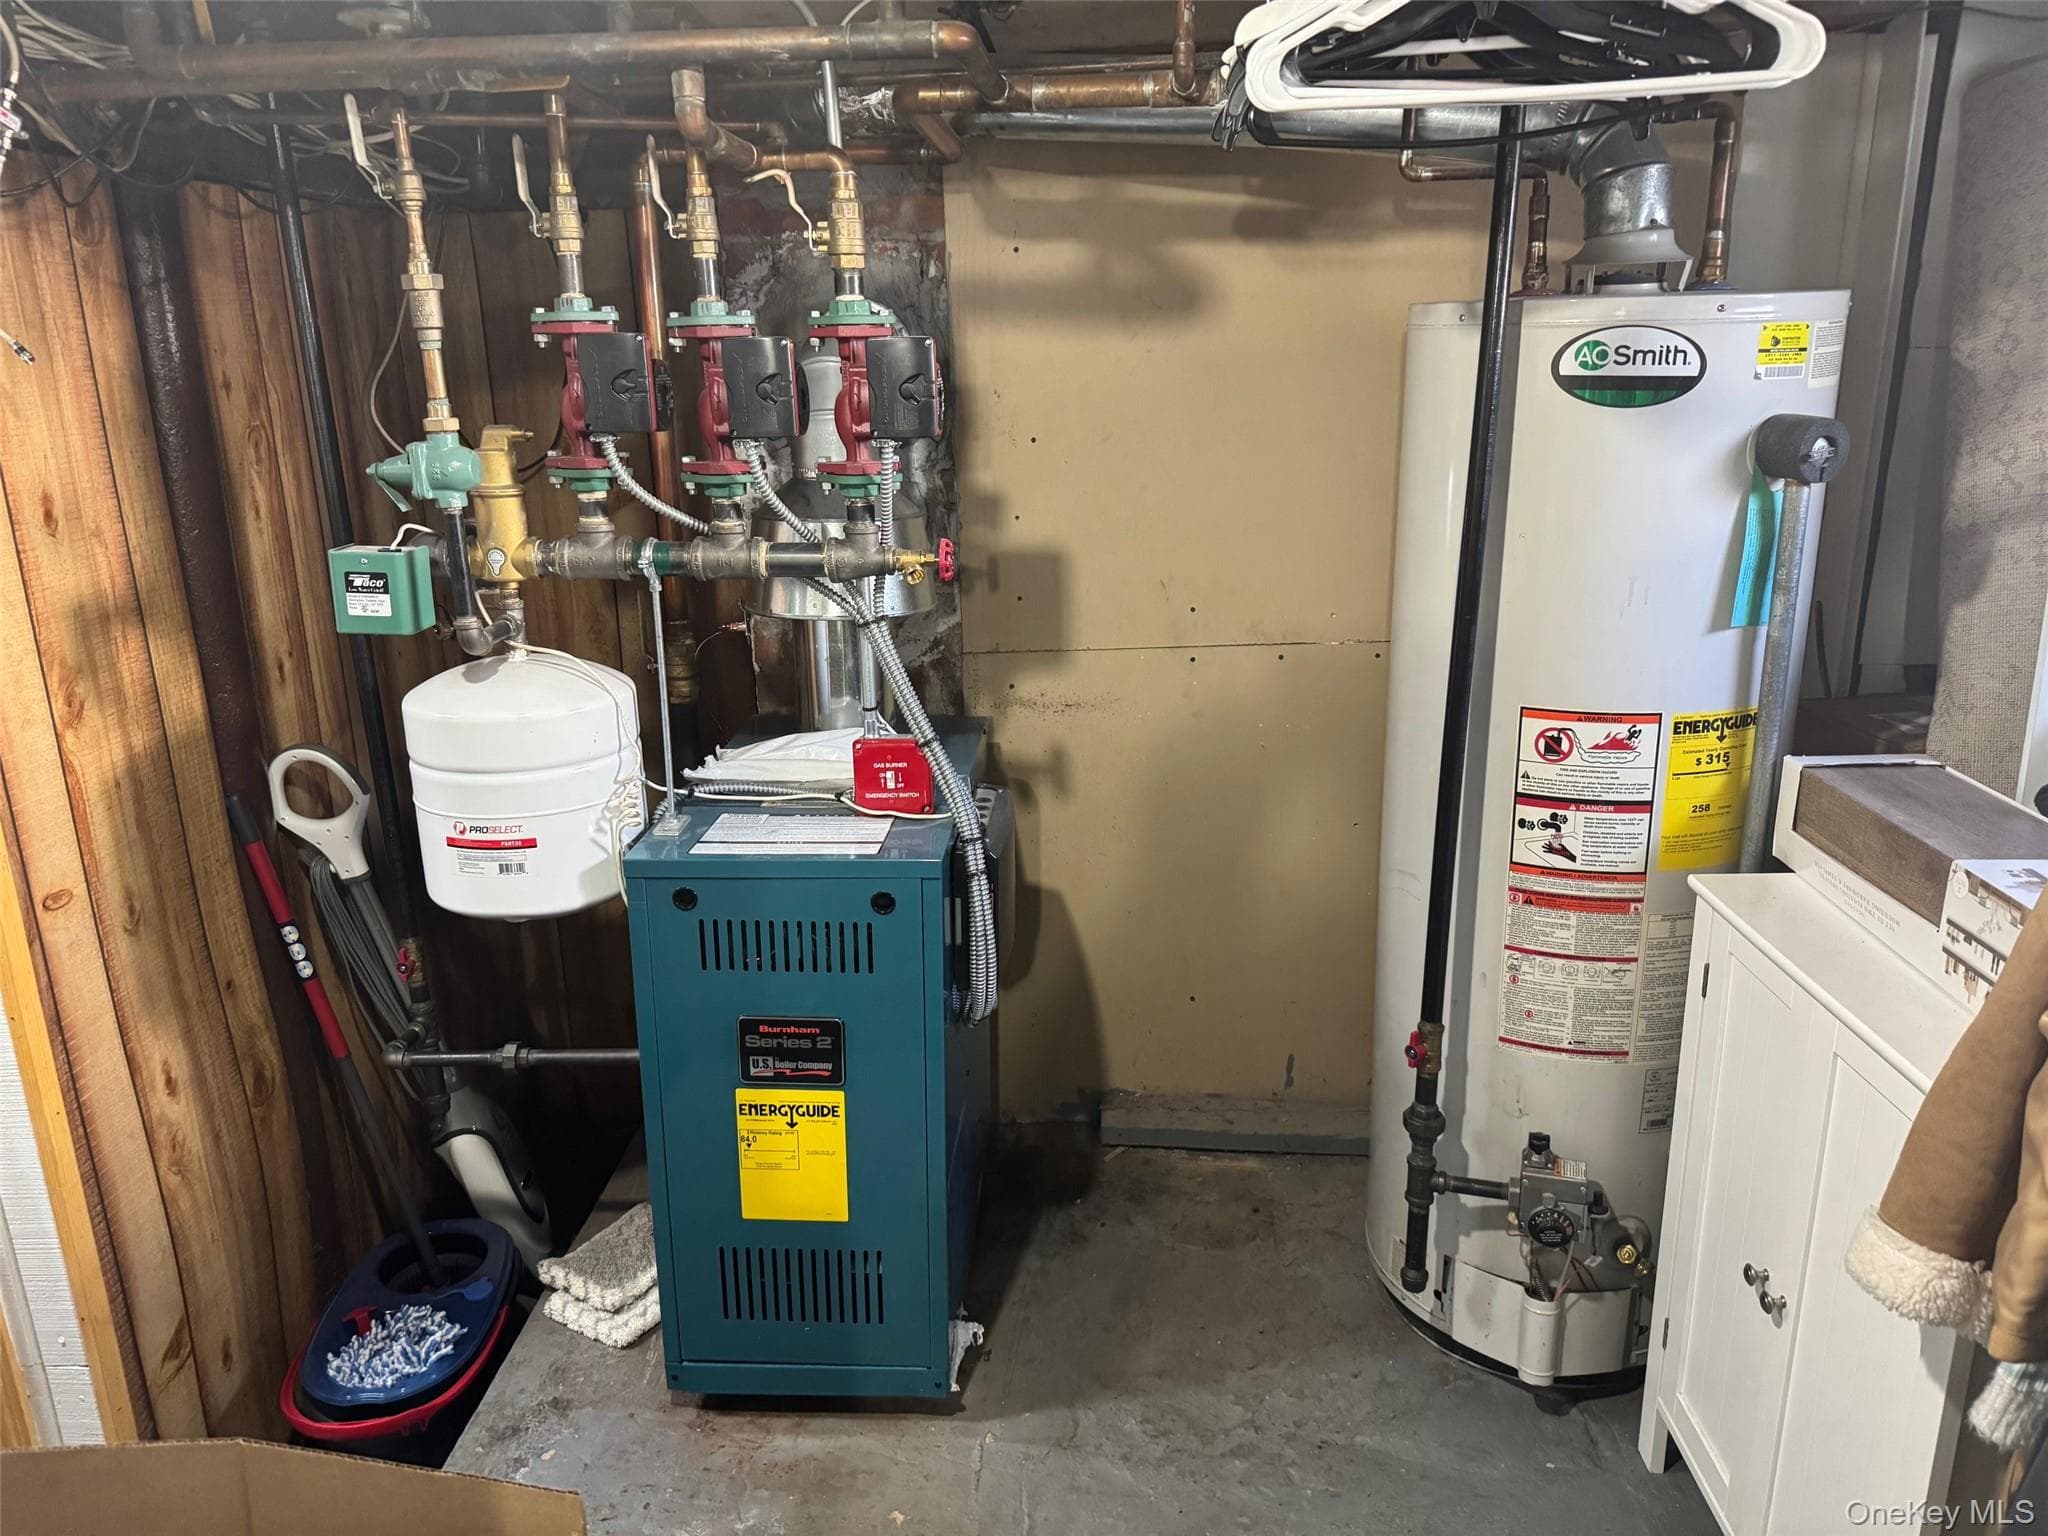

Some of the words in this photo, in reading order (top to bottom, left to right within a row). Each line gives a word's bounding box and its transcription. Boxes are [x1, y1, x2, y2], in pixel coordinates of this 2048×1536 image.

[1613, 345, 1688, 366] Smith
[1705, 752, 1730, 765] 315
[1579, 804, 1615, 812] DANGER
[1691, 803, 1711, 813] 258
[759, 1025, 820, 1033] Burnham
[745, 1035, 812, 1049] Series
[816, 1036, 832, 1049] 2
[752, 1057, 772, 1069] U.S.
[775, 1061, 797, 1069] Boiler
[798, 1061, 833, 1070] Company
[739, 1103, 840, 1118] ENERGYGUIDE
[740, 1135, 757, 1143] 84.0
